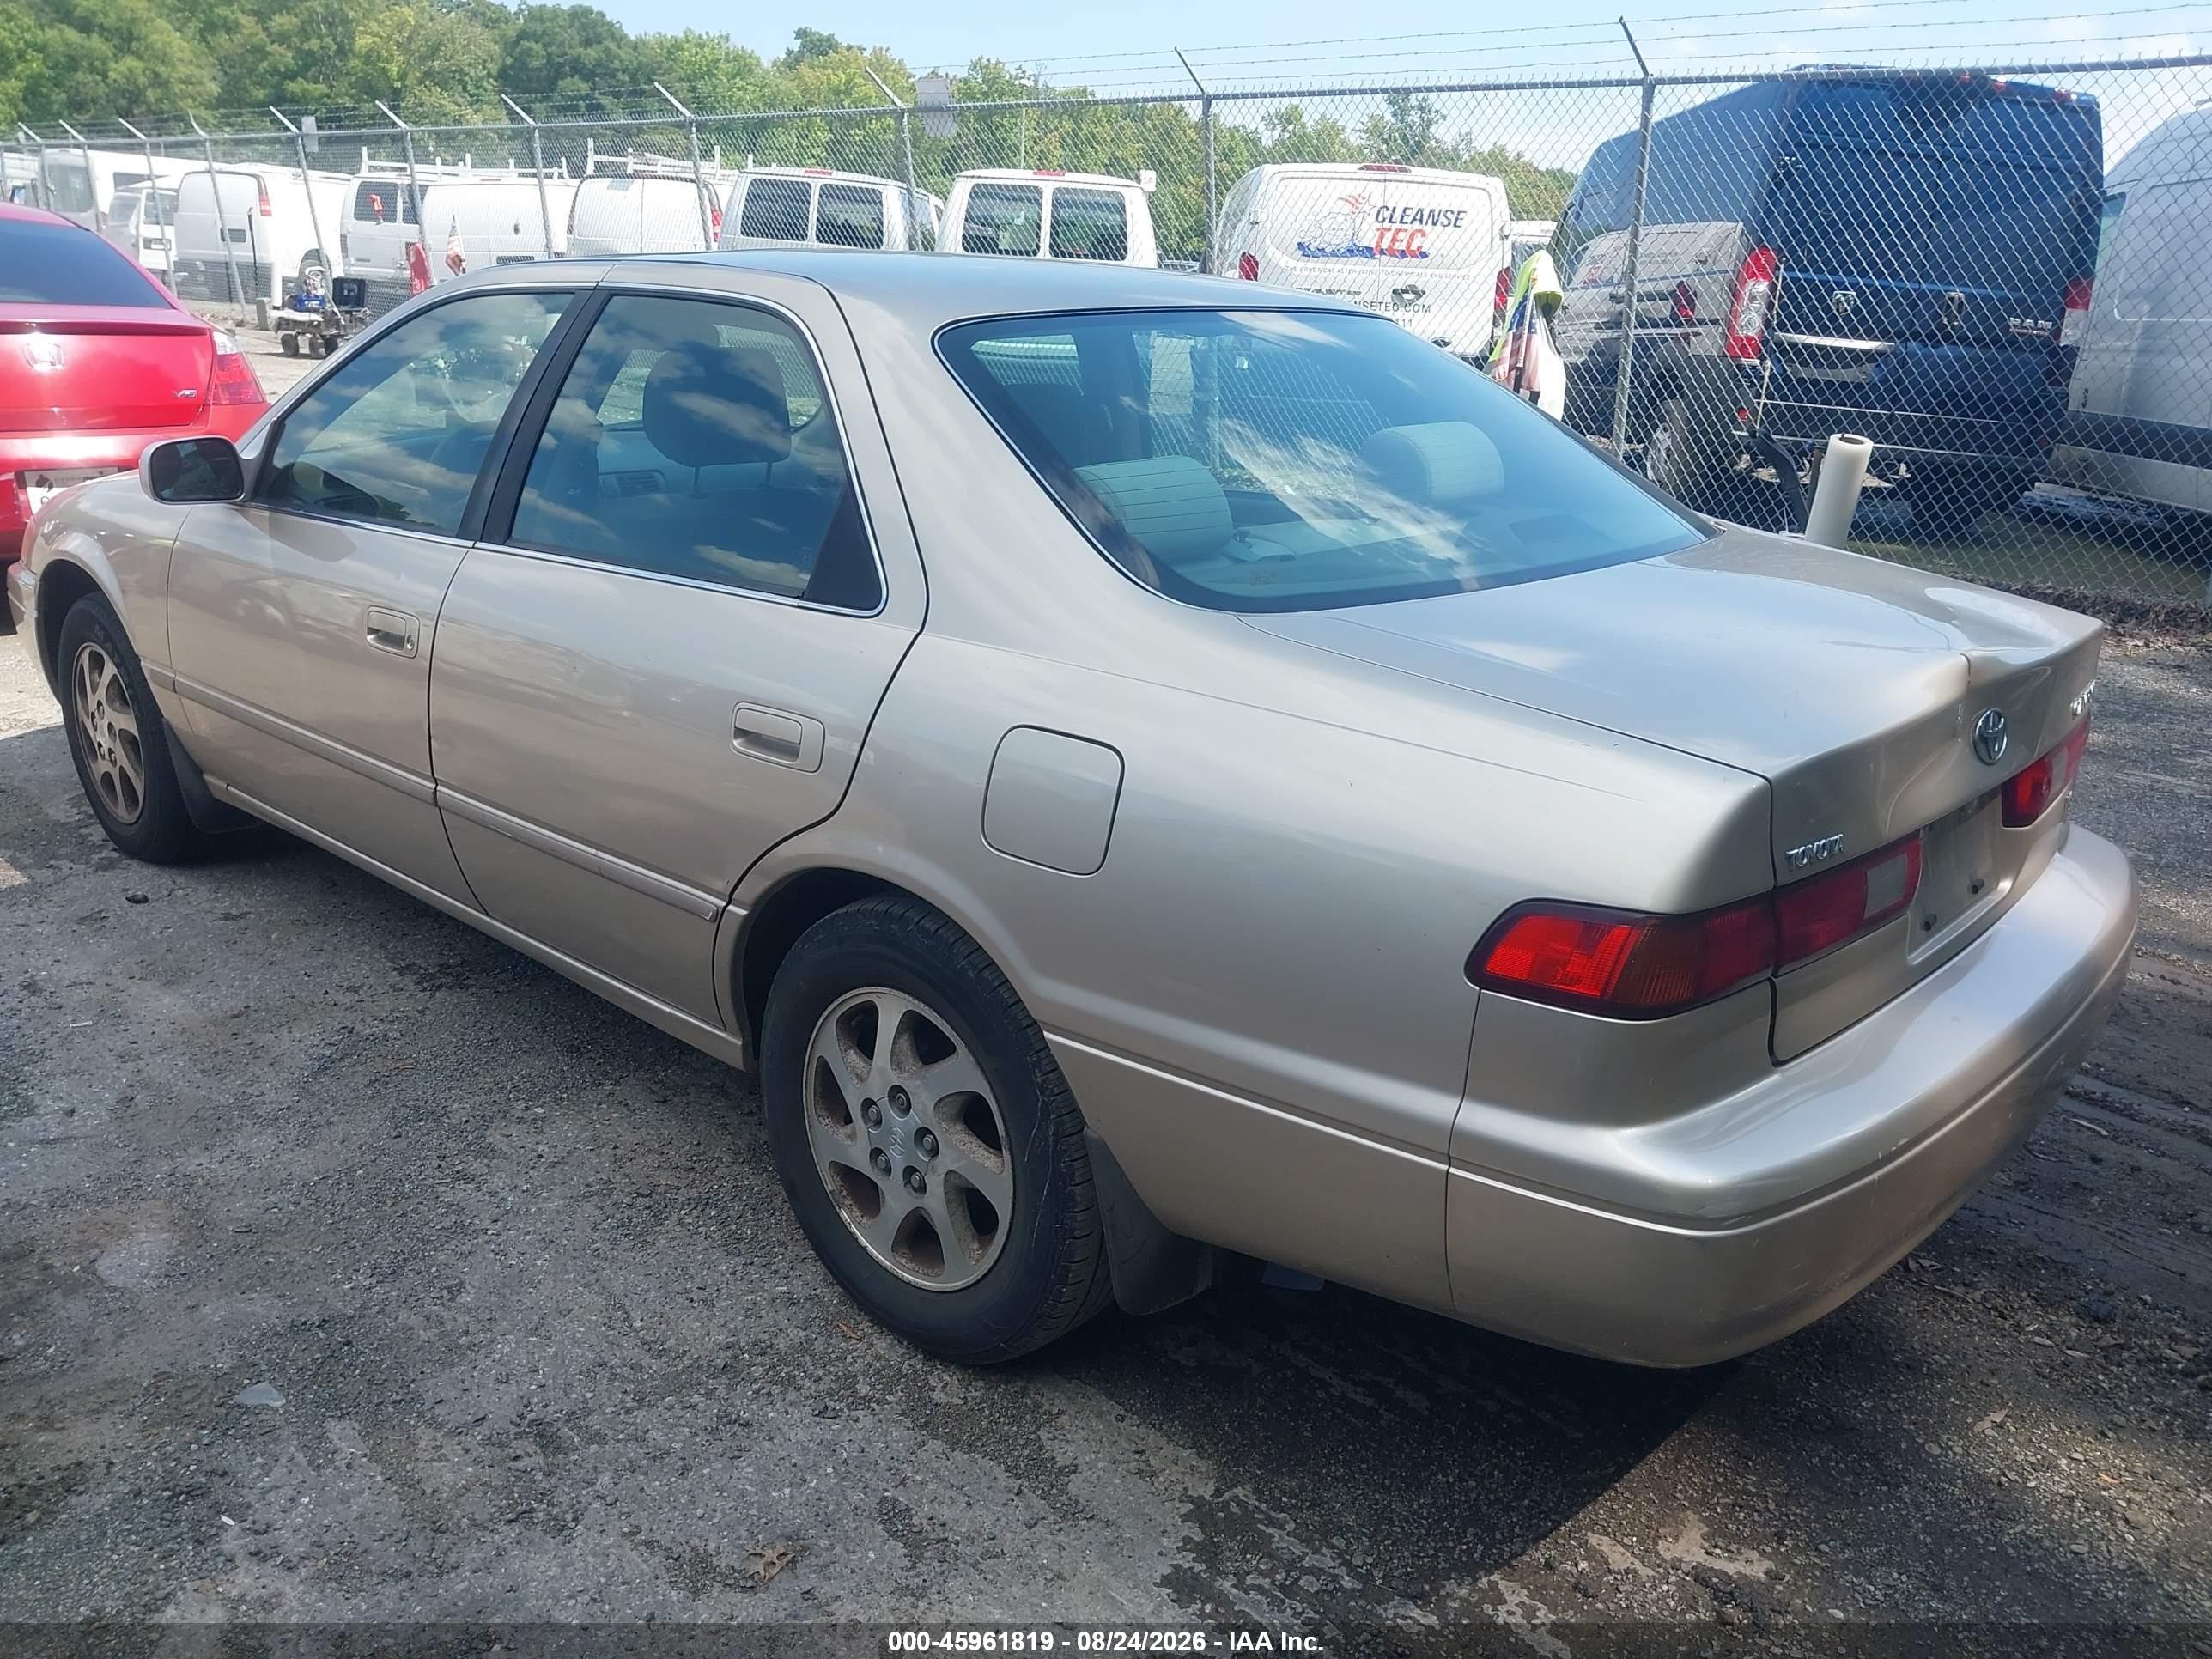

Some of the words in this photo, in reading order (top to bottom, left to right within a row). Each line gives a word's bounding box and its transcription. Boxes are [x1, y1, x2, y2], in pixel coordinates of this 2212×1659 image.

[1376, 205, 1468, 228] CLEANSE
[1373, 227, 1427, 258] TEC
[1785, 833, 1844, 867] TOYOTA
